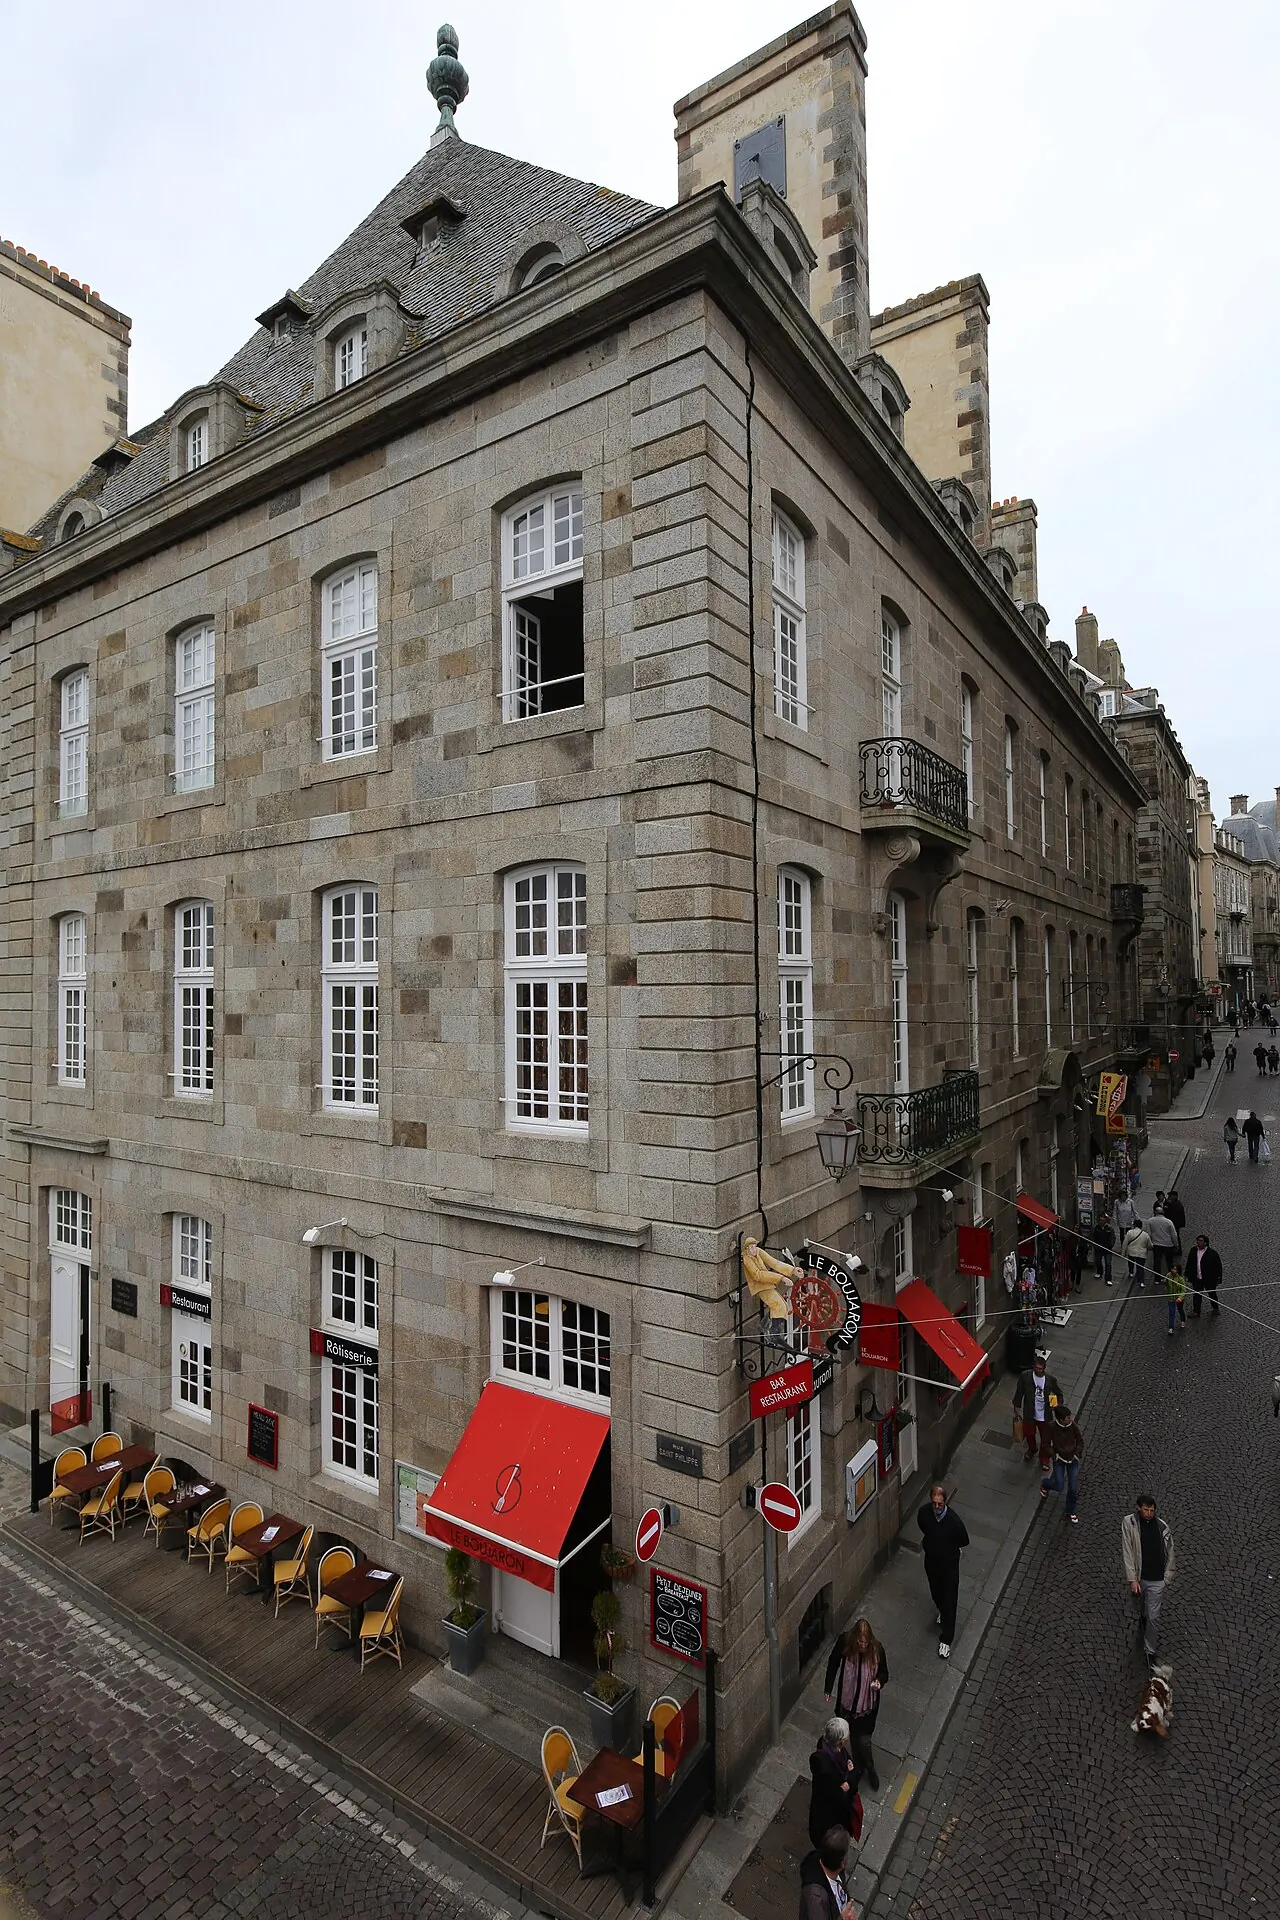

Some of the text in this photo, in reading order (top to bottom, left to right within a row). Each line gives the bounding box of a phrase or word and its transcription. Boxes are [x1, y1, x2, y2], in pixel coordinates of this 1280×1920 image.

[1108, 1081, 1125, 1112] TABAC
[171, 1291, 209, 1314] Restaurant
[808, 1253, 861, 1345] LE BOUJARON
[326, 1339, 373, 1366] Rôtisserie
[861, 1352, 889, 1362] BOUJARON
[759, 1381, 808, 1408] RESTAURANT
[769, 1376, 787, 1390] BAR
[672, 1443, 684, 1452] RUE
[449, 1527, 525, 1573] LE BOUJARON
